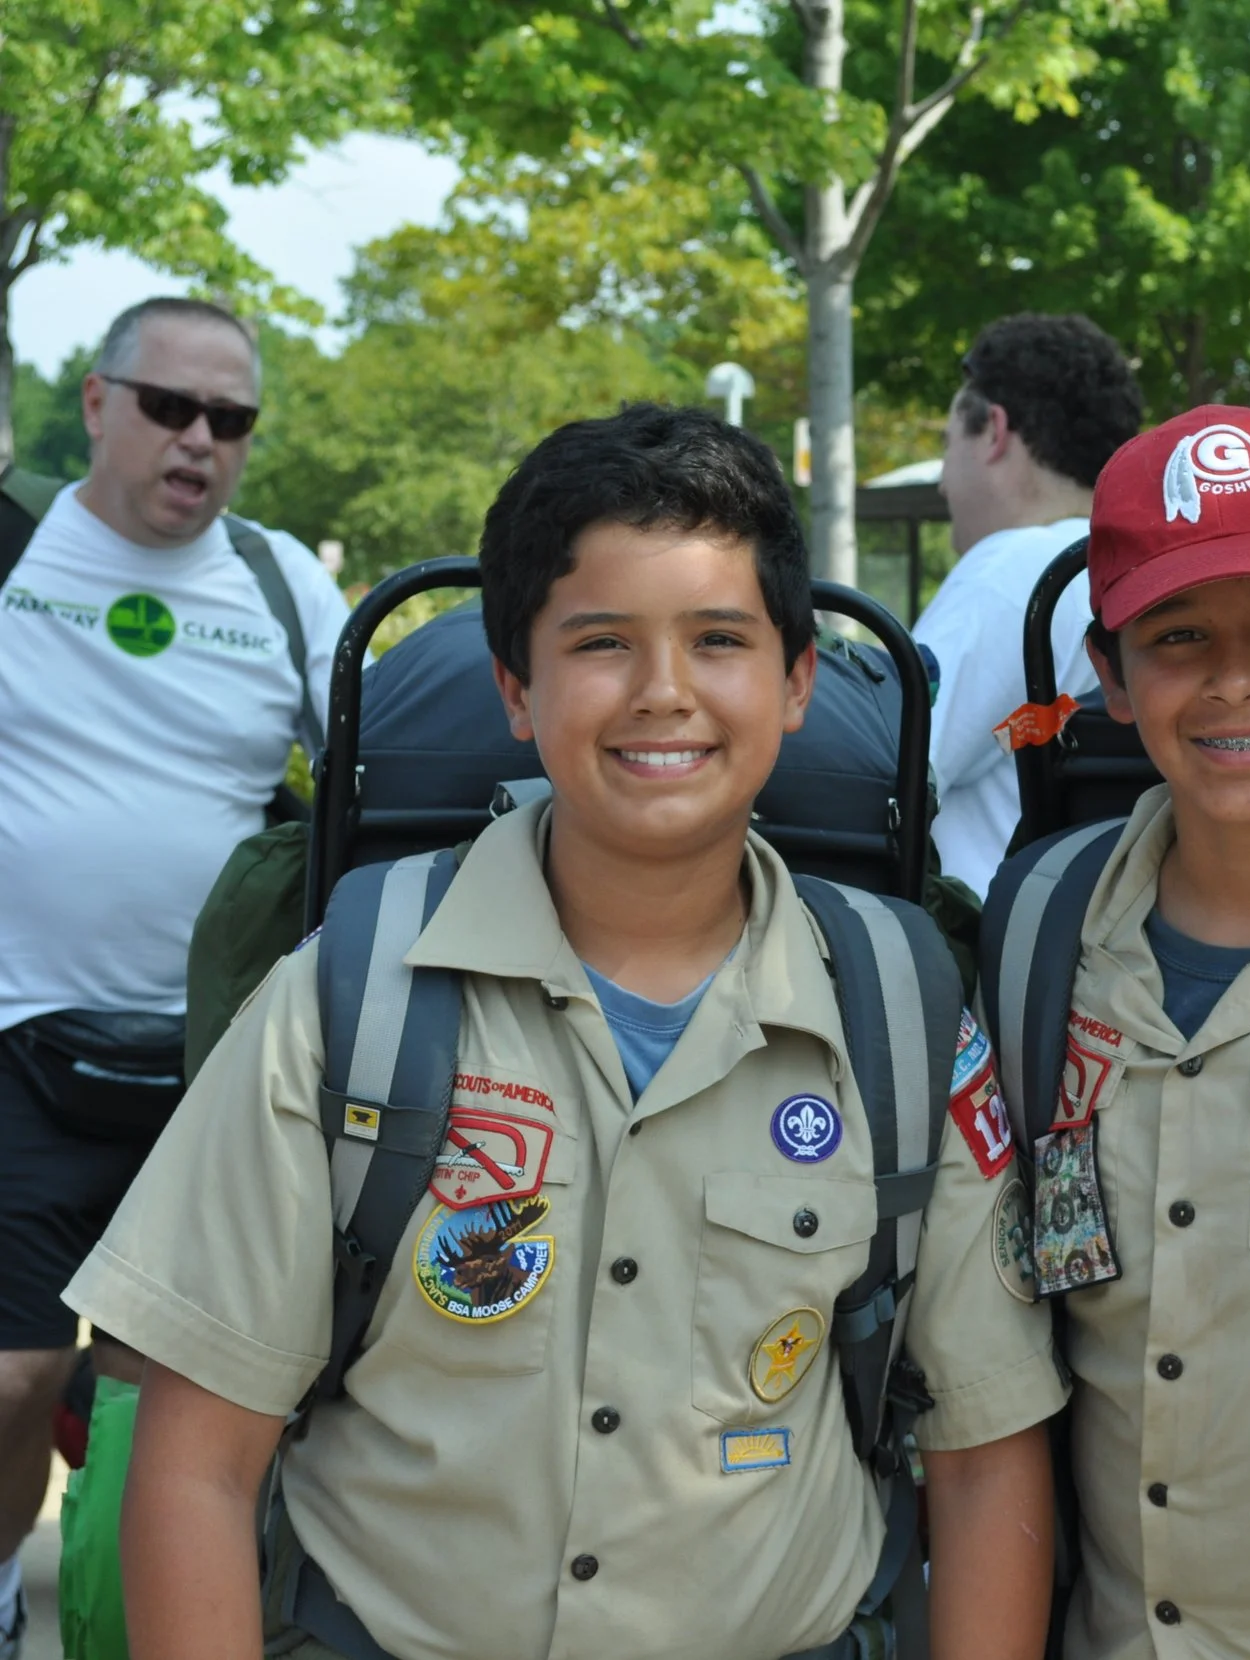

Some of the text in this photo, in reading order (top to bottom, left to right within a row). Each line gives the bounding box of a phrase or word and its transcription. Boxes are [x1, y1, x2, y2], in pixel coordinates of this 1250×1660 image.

[1197, 433, 1250, 471] G
[183, 620, 273, 652] CLASSIC
[457, 1169, 481, 1182] CHIP
[998, 1218, 1011, 1268] SENIOR
[447, 1242, 549, 1318] BSA MOOSE CAMPOREE
